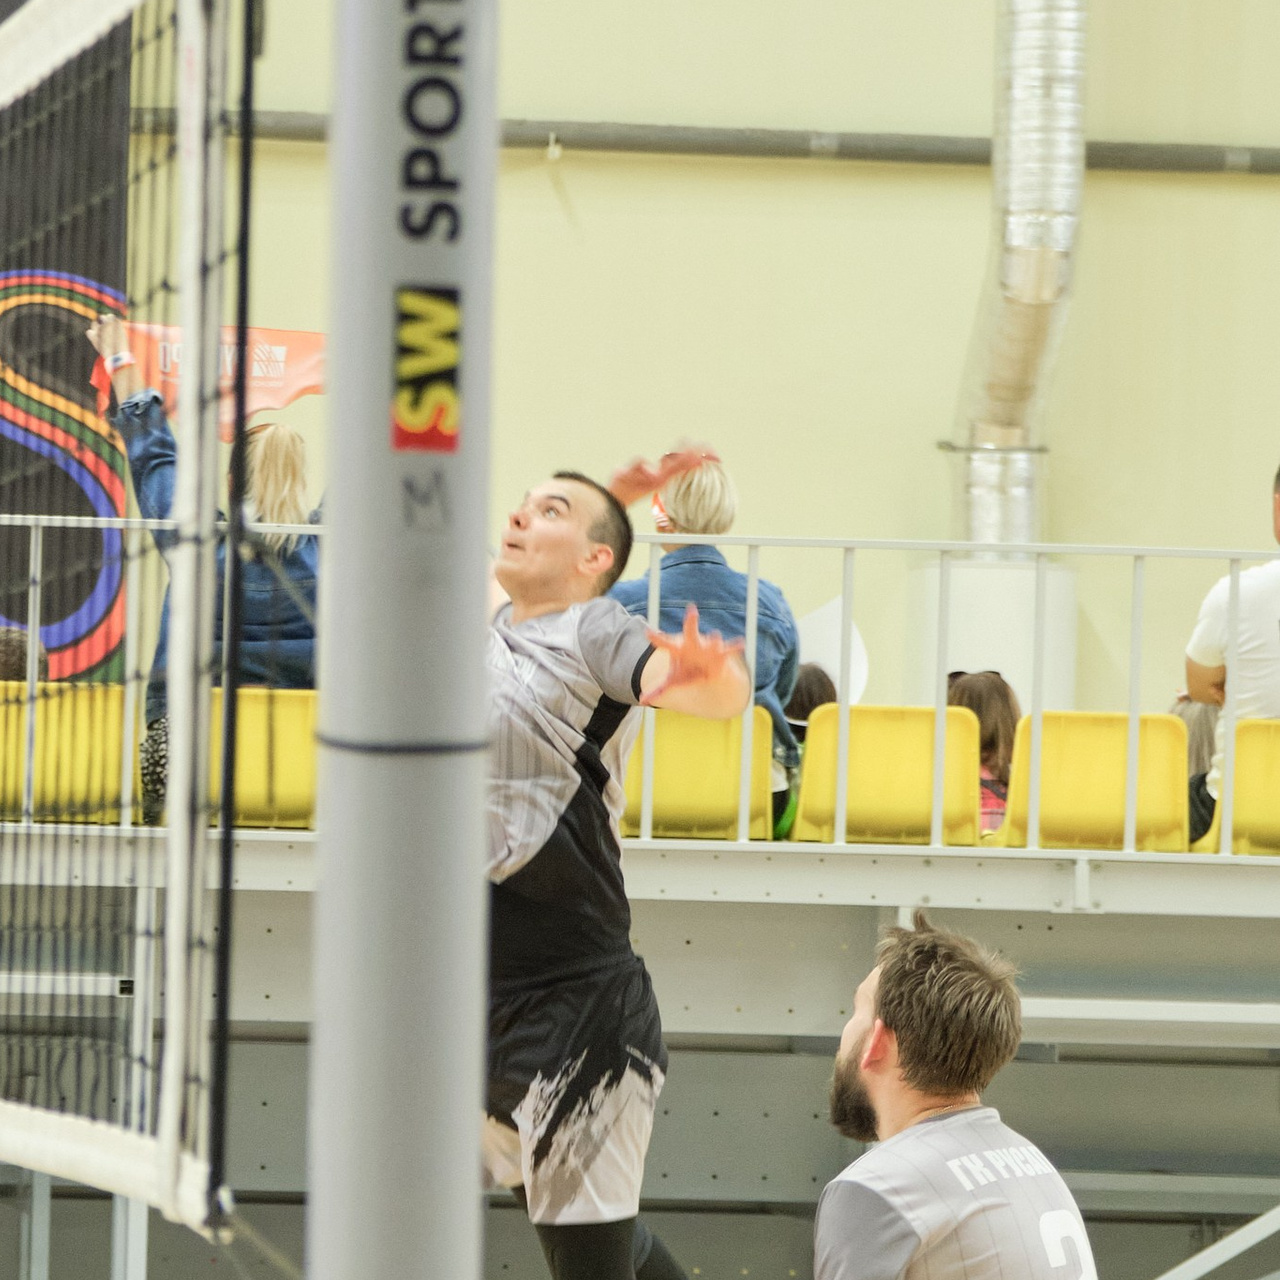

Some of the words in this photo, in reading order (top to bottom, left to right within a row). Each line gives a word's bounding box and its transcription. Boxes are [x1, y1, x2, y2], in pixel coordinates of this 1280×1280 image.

[393, 287, 462, 438] SW
[945, 1153, 998, 1192] ГК
[982, 1145, 1057, 1180] РУСА
